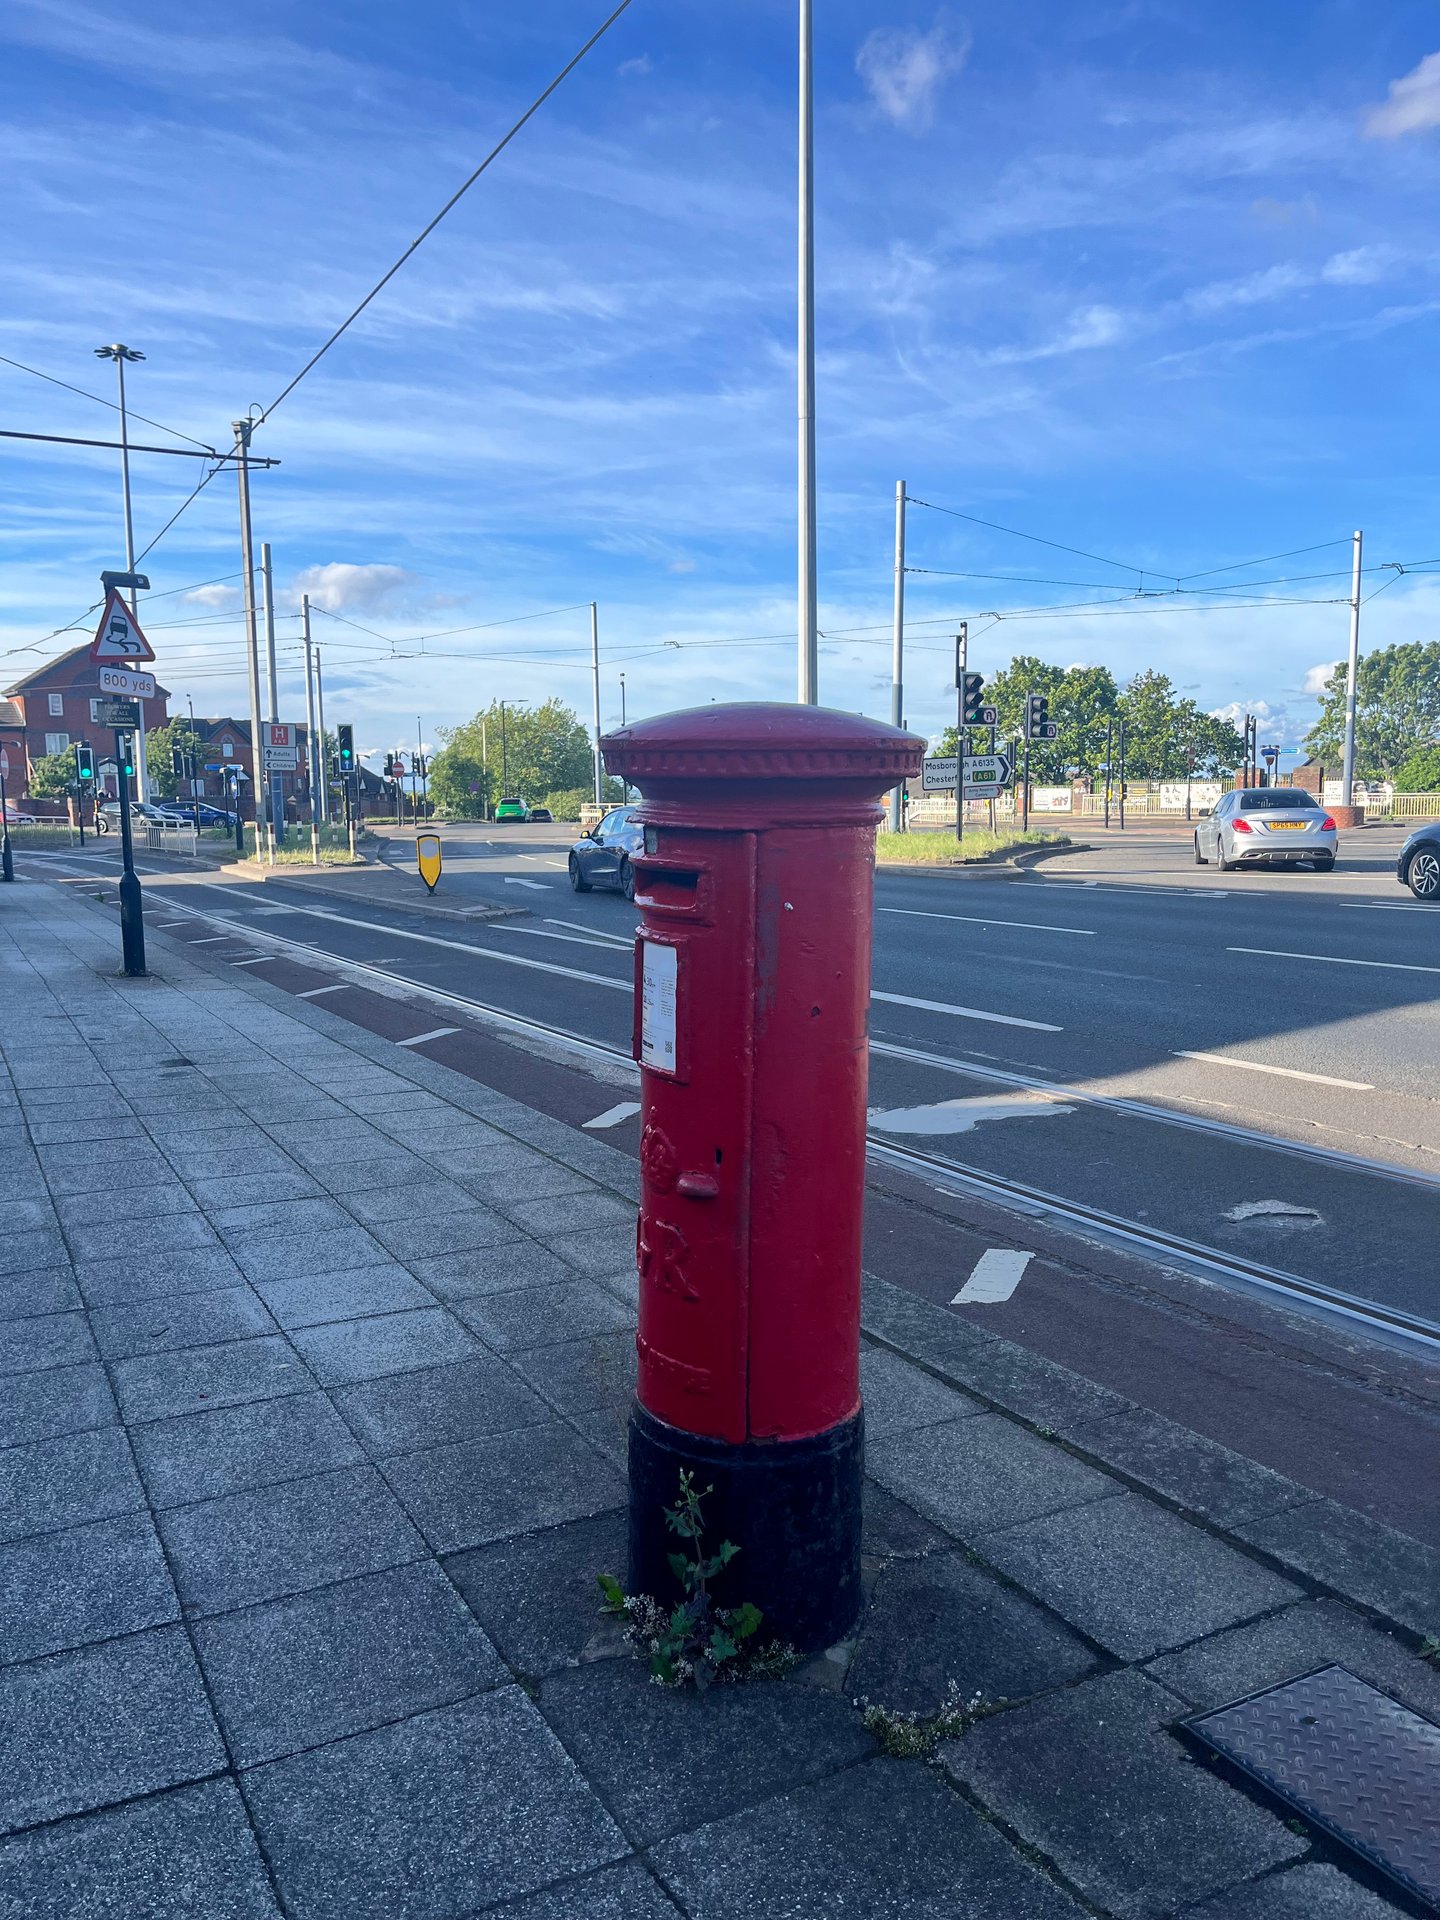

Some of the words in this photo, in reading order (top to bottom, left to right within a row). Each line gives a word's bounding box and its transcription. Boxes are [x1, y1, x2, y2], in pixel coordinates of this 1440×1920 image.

[103, 673, 127, 688] 800
[132, 679, 151, 692] yds
[276, 728, 284, 738] H
[926, 760, 969, 770] Mosboroh
[926, 773, 971, 784] Chesterfld
